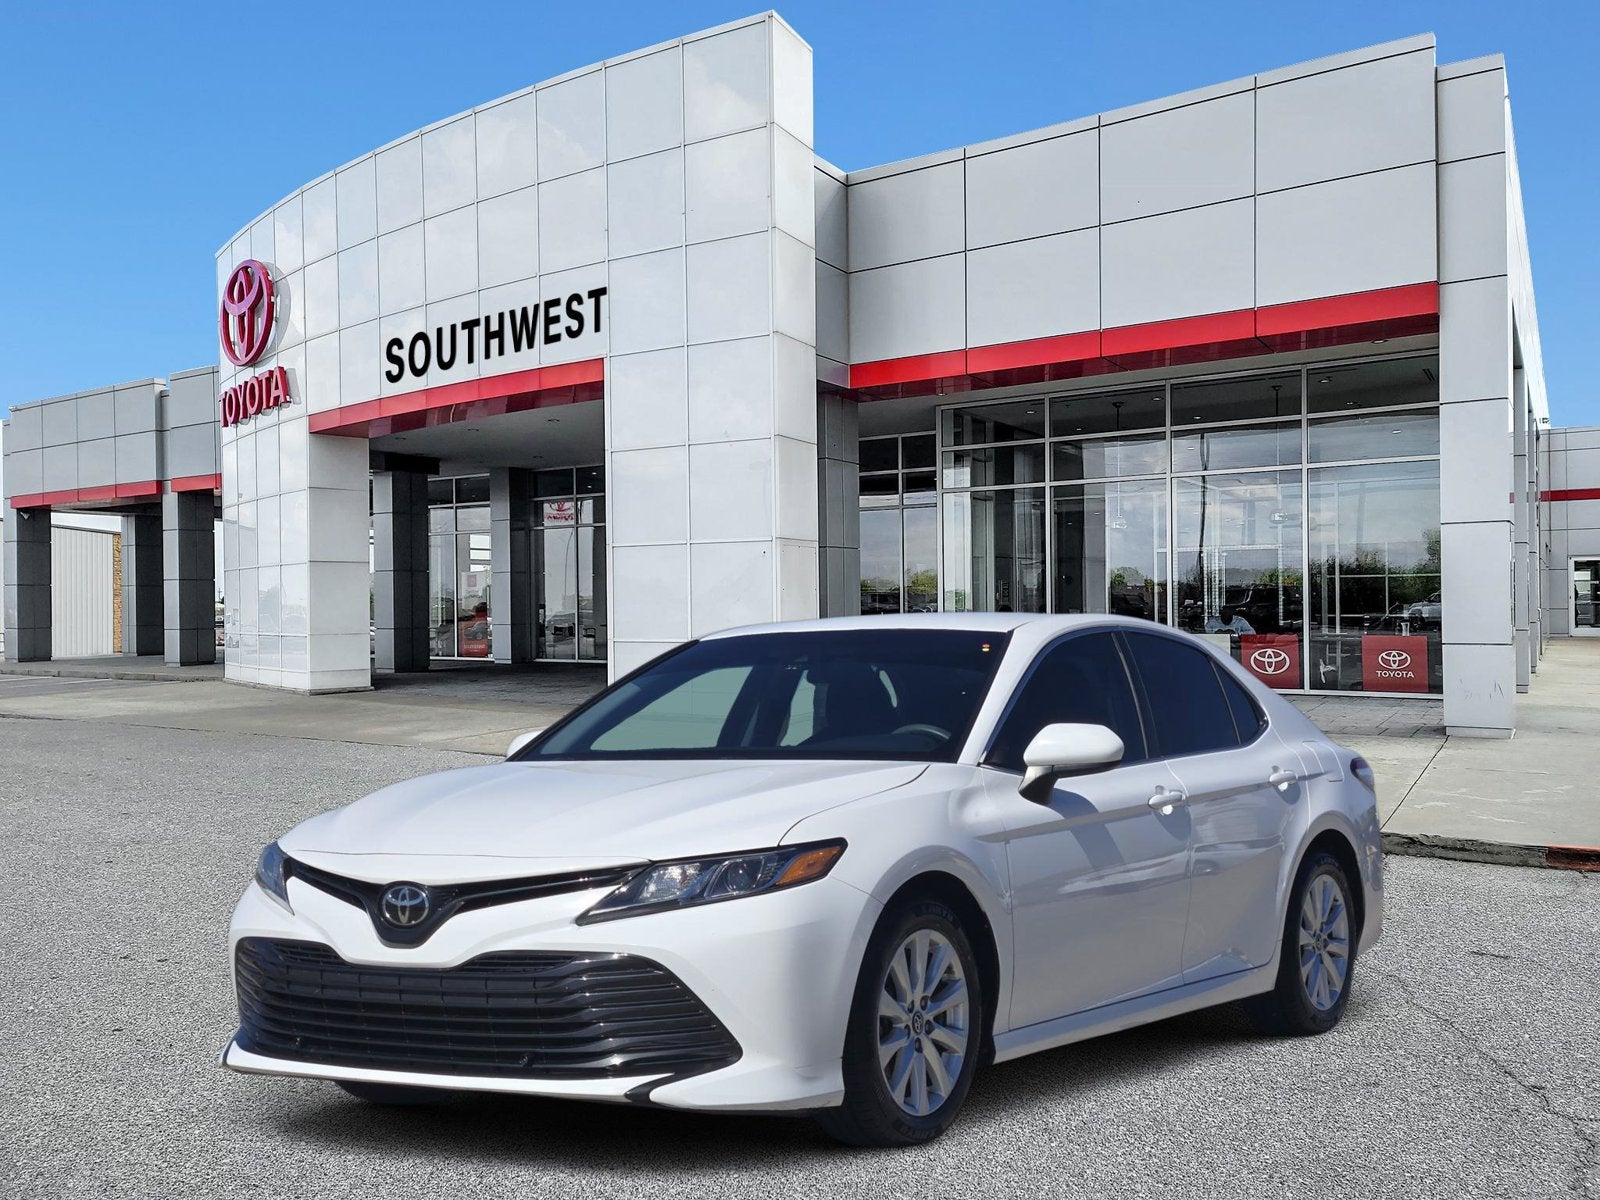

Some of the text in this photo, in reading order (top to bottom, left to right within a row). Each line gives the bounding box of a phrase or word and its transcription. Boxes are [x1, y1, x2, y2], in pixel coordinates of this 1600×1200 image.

[385, 286, 607, 383] SOUTHWEST
[218, 366, 289, 427] TOYOTA
[1376, 670, 1414, 678] TOYOTA
